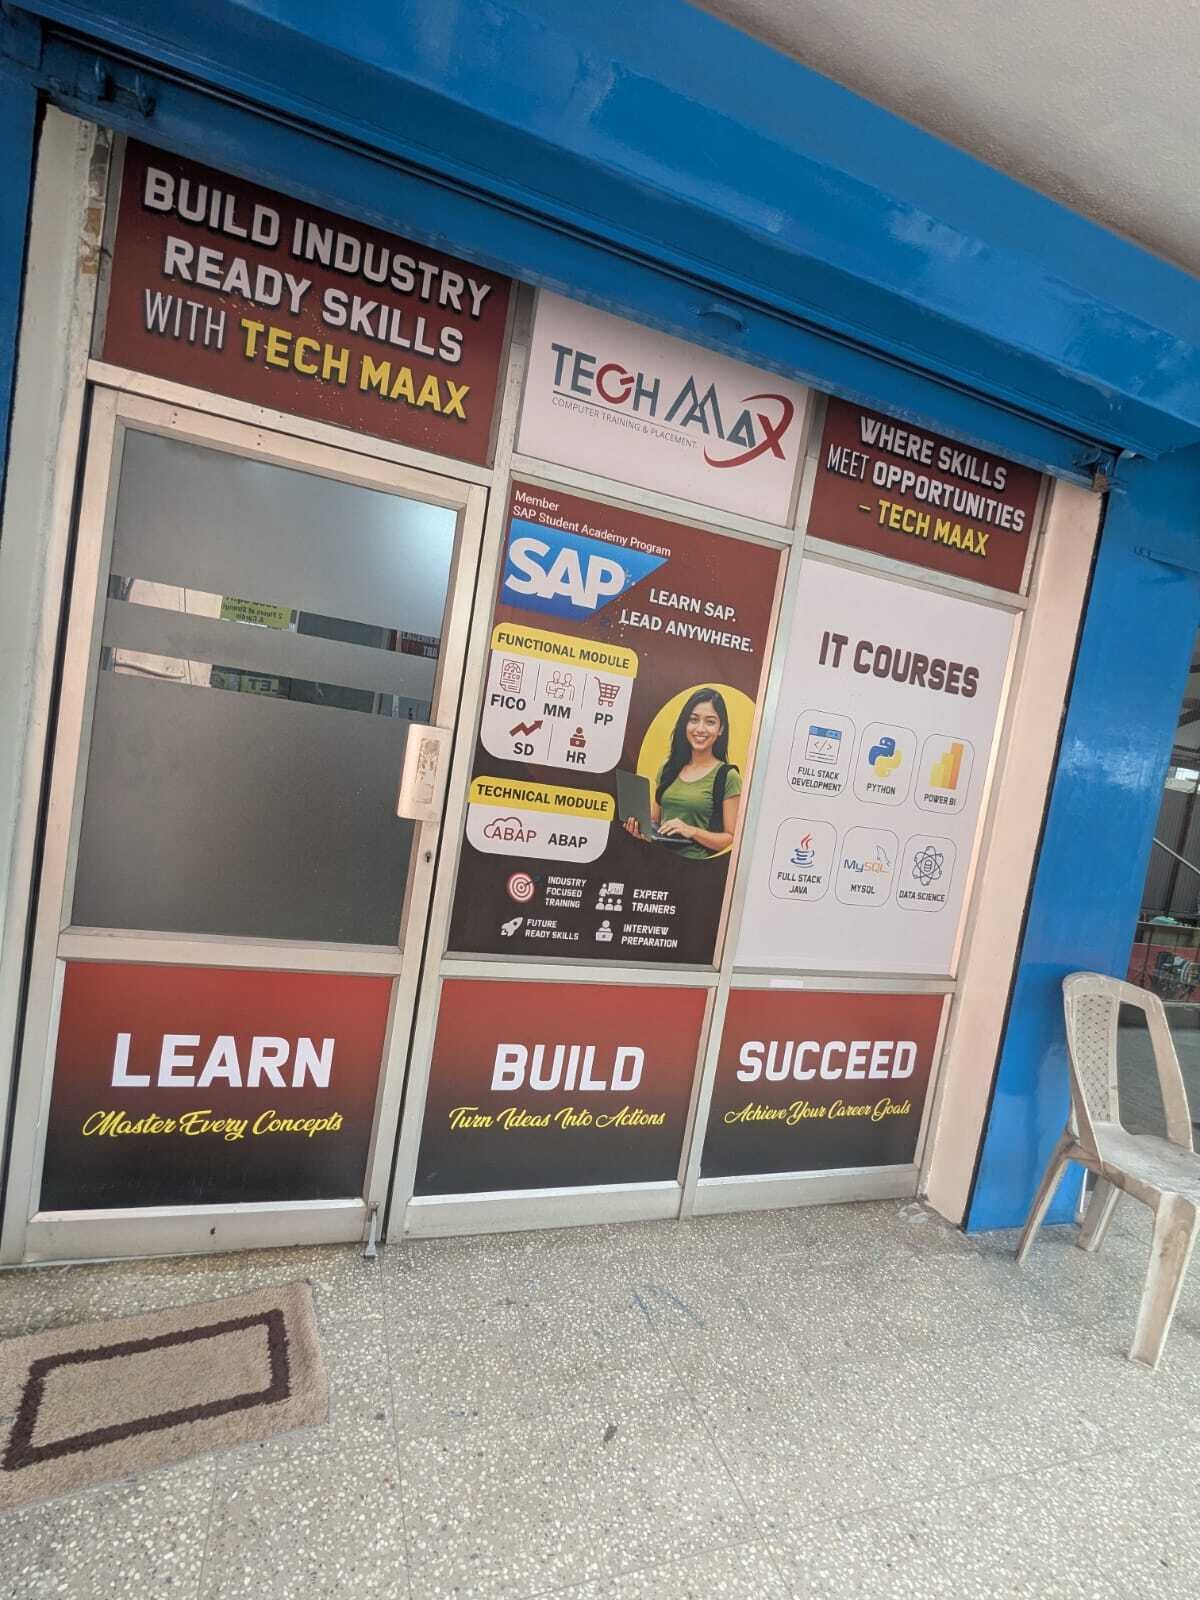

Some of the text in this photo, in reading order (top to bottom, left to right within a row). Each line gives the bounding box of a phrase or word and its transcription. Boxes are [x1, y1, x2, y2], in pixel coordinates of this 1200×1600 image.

[144, 167, 492, 317] BUILD INDUSTRY
[164, 236, 464, 363] READY SKILLS
[145, 288, 471, 420] WITH TECH MAAX
[551, 343, 660, 417] TECH
[552, 397, 599, 417] COMPUTER
[602, 412, 641, 432] TRAINING
[642, 425, 649, 434] &
[861, 416, 1007, 490] WHERE SKILLS
[827, 444, 1026, 532] MEET OPPORTUNITIES
[515, 490, 560, 512] Member
[513, 505, 671, 557] SAP Student Academy Program
[878, 499, 931, 538] TECH
[934, 519, 990, 556] MAAX
[504, 537, 625, 610] SAP
[650, 588, 736, 622] LEARN SAP.
[620, 608, 753, 653] LEAD ANYWHERE.
[497, 632, 630, 669] FUNCTIONAL MODULE
[818, 631, 980, 698] IT COURSES
[490, 693, 526, 711] FICO
[543, 703, 571, 719] MM
[594, 712, 614, 726] PP
[513, 742, 534, 756] SD
[566, 750, 587, 765] HR
[797, 766, 840, 781] FULL STACK
[791, 777, 842, 792] DEVELOPMENT
[866, 783, 896, 795] PYTHON
[477, 784, 609, 812] TECHNICAL MODULE
[923, 793, 957, 807] POWER BI
[491, 827, 537, 843] ABAP
[548, 833, 588, 849] ABAP
[844, 858, 889, 874] MySQL
[548, 876, 587, 888] INDUSTRY
[777, 871, 822, 885] FULL STACK
[546, 887, 583, 898] FOCUSED
[633, 889, 669, 901] EXPERT
[789, 885, 808, 895] JAVA
[850, 884, 876, 895] MYSQL
[899, 890, 945, 903] DATA SCIENCE
[545, 897, 580, 909] TRAINING
[631, 902, 676, 915] TRAINERS
[526, 918, 558, 929] FUTURE
[623, 923, 669, 936] INTERVIEW
[525, 929, 580, 941] READY SKILLS
[621, 935, 679, 949] PREPARATION
[111, 1032, 336, 1088] LEARN
[490, 1043, 645, 1091] BUILD
[736, 1040, 918, 1082] SUCCEED
[449, 1104, 667, 1130] Turn Ideas Into Actions
[724, 1097, 911, 1126] Achieve Your Career Goals
[82, 1109, 344, 1142] Master Every Concepts
